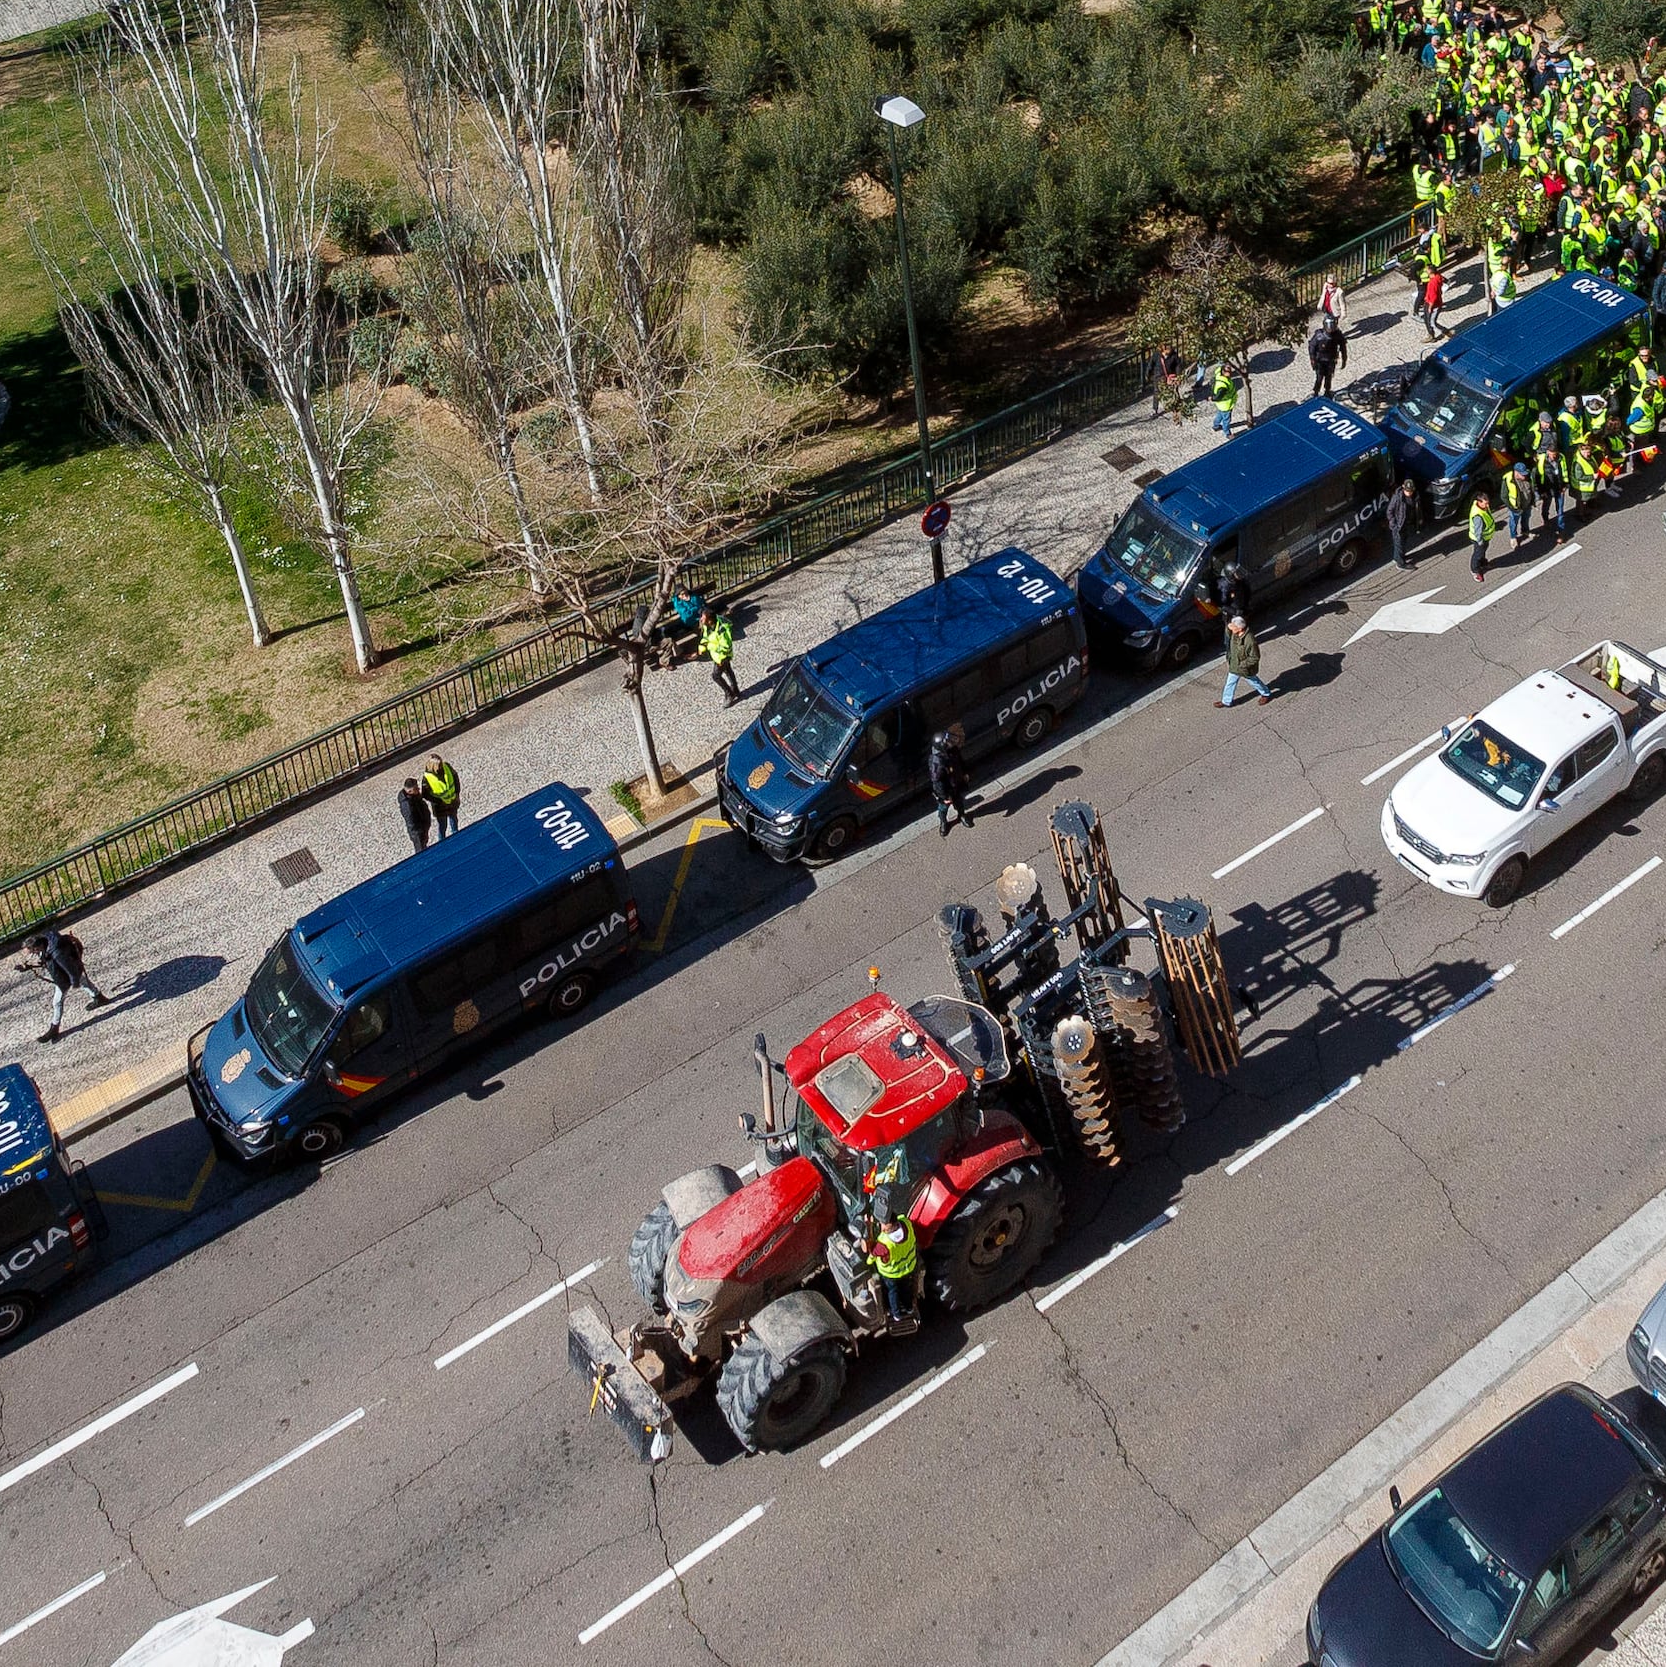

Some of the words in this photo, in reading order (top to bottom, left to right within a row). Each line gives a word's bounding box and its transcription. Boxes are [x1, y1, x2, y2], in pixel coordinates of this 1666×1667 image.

[1571, 278, 1625, 307] 11U-20
[1308, 406, 1362, 440] 11U-22
[1318, 491, 1390, 555] POLICIA
[997, 560, 1056, 604] 11U-12
[996, 655, 1081, 727] POLICIA
[535, 800, 590, 850] 11U-02
[570, 862, 602, 883] 11U-02
[519, 911, 627, 998] POLICIA
